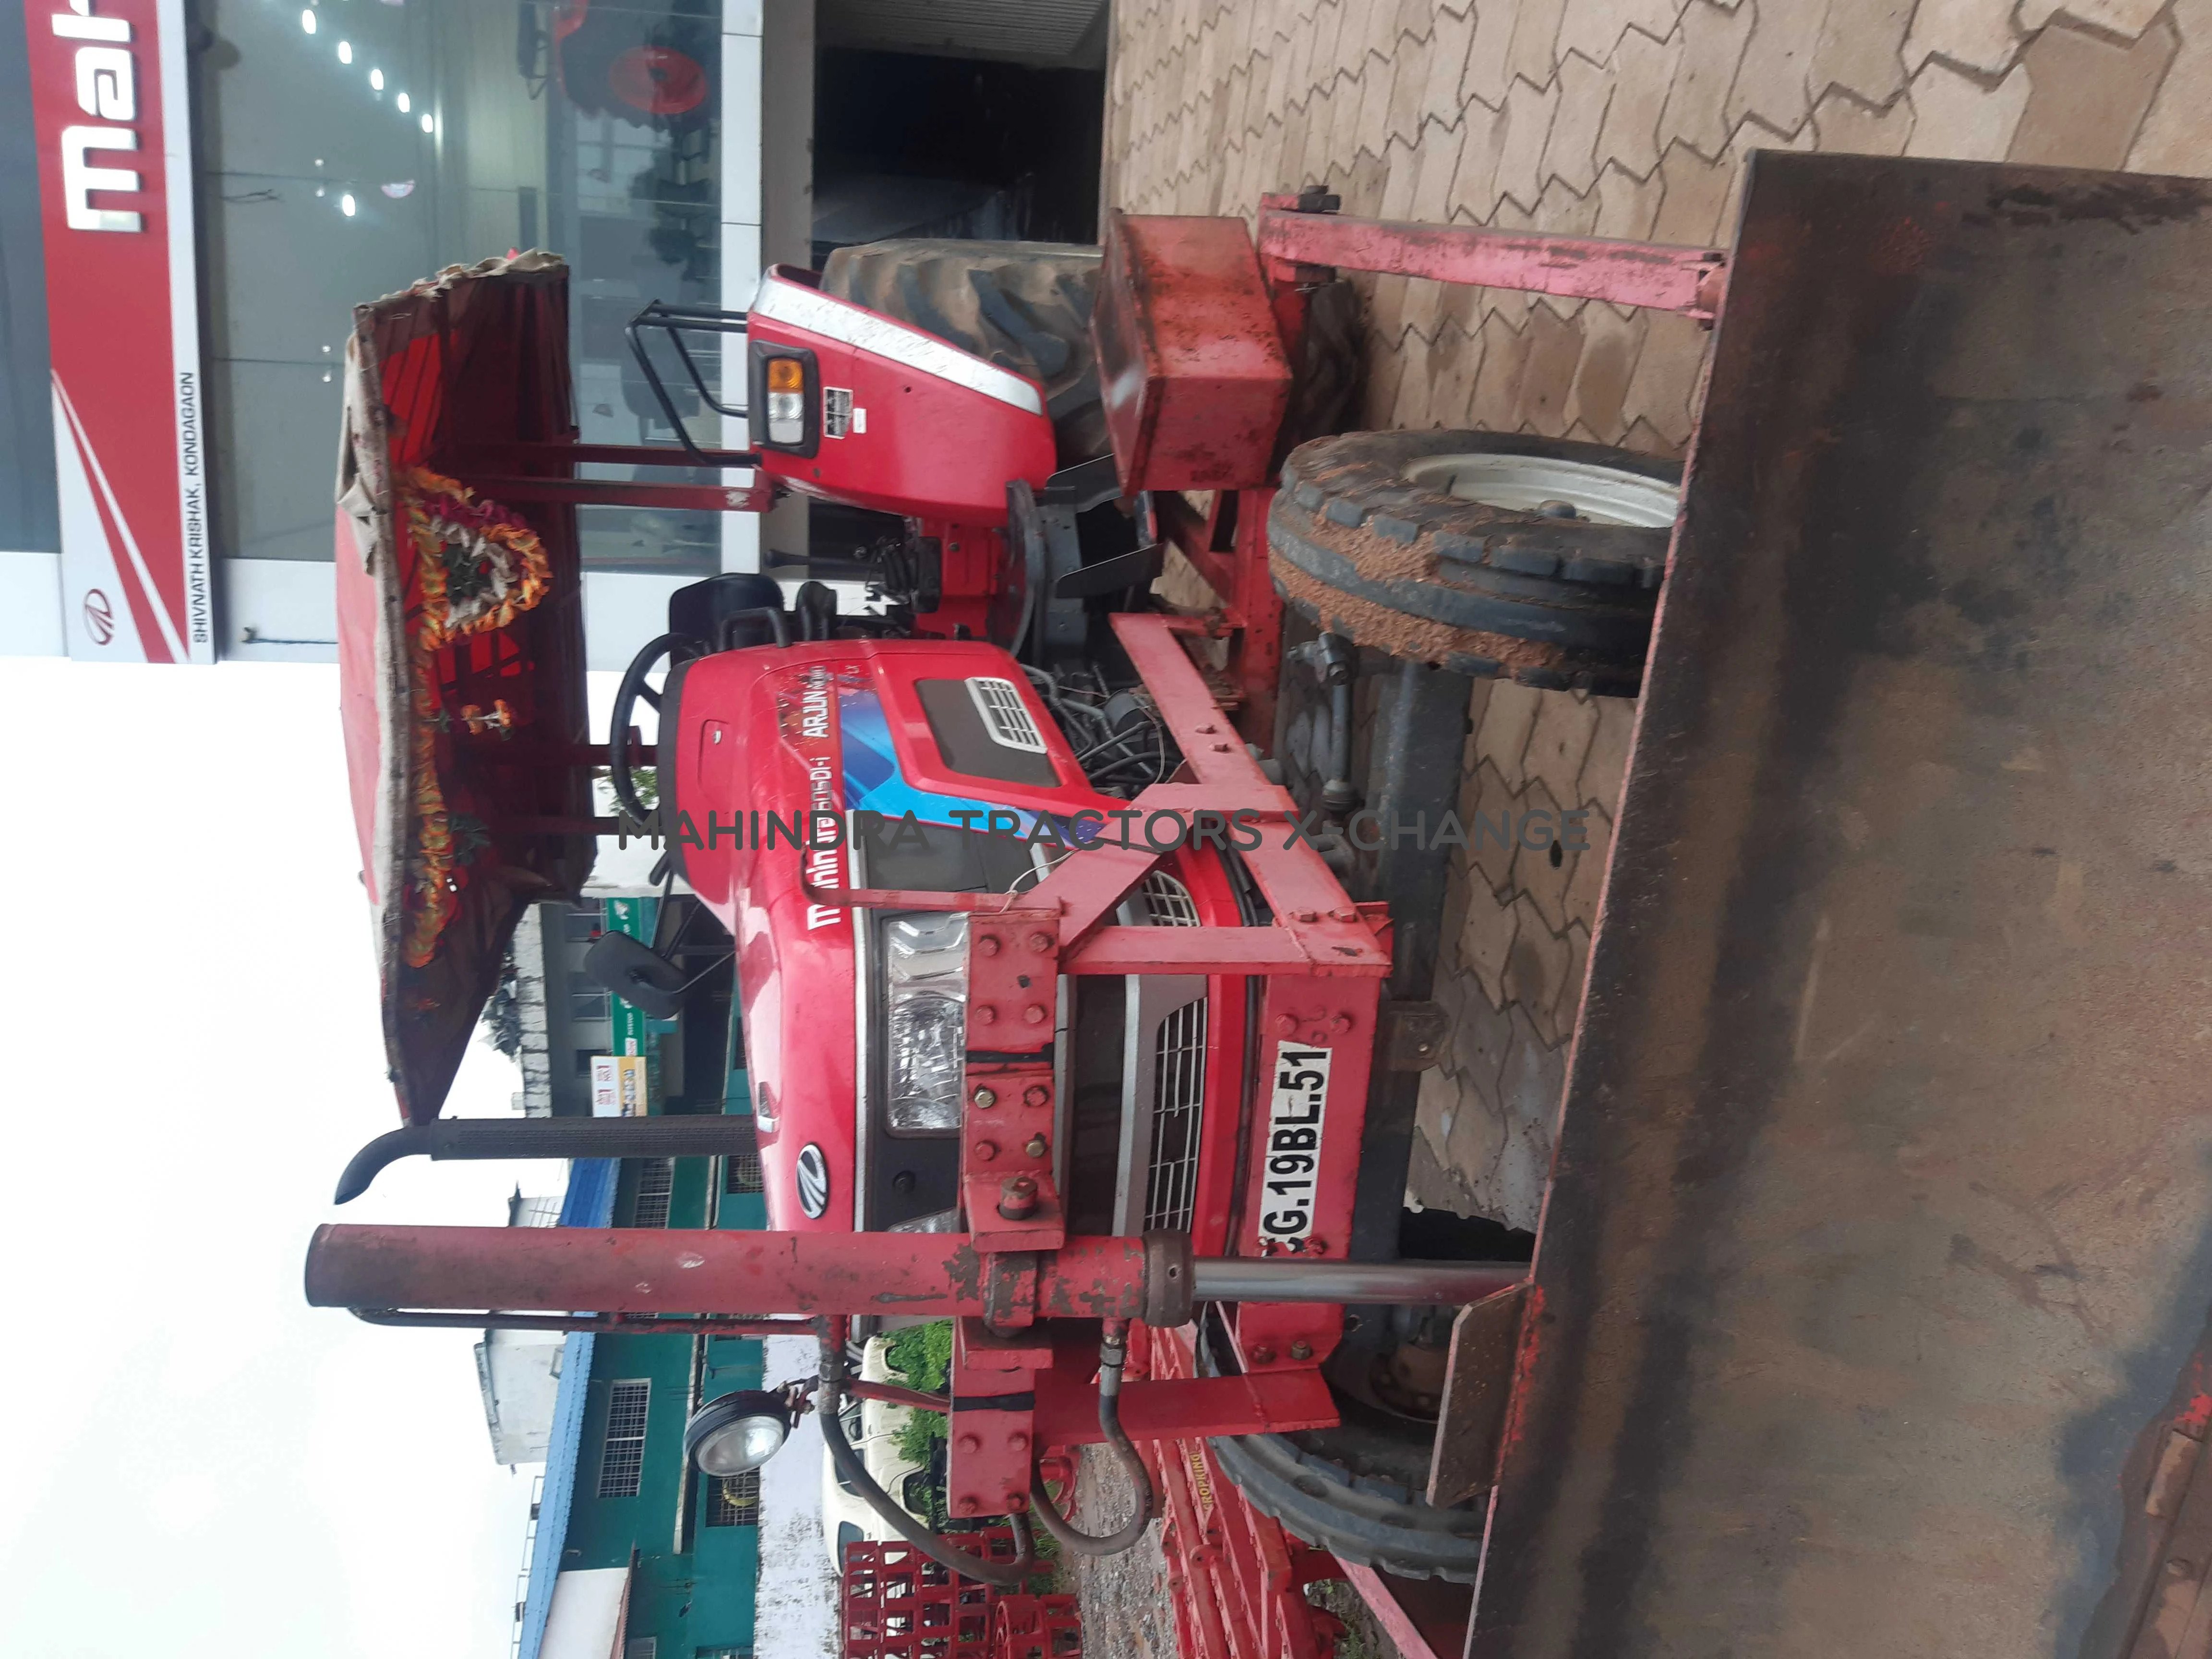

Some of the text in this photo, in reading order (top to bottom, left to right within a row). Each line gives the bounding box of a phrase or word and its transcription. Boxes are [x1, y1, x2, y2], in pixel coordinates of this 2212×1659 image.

[180, 371, 198, 477] KONDAGAON
[190, 563, 208, 644] SHIVNATH
[801, 690, 830, 738] ARJUN
